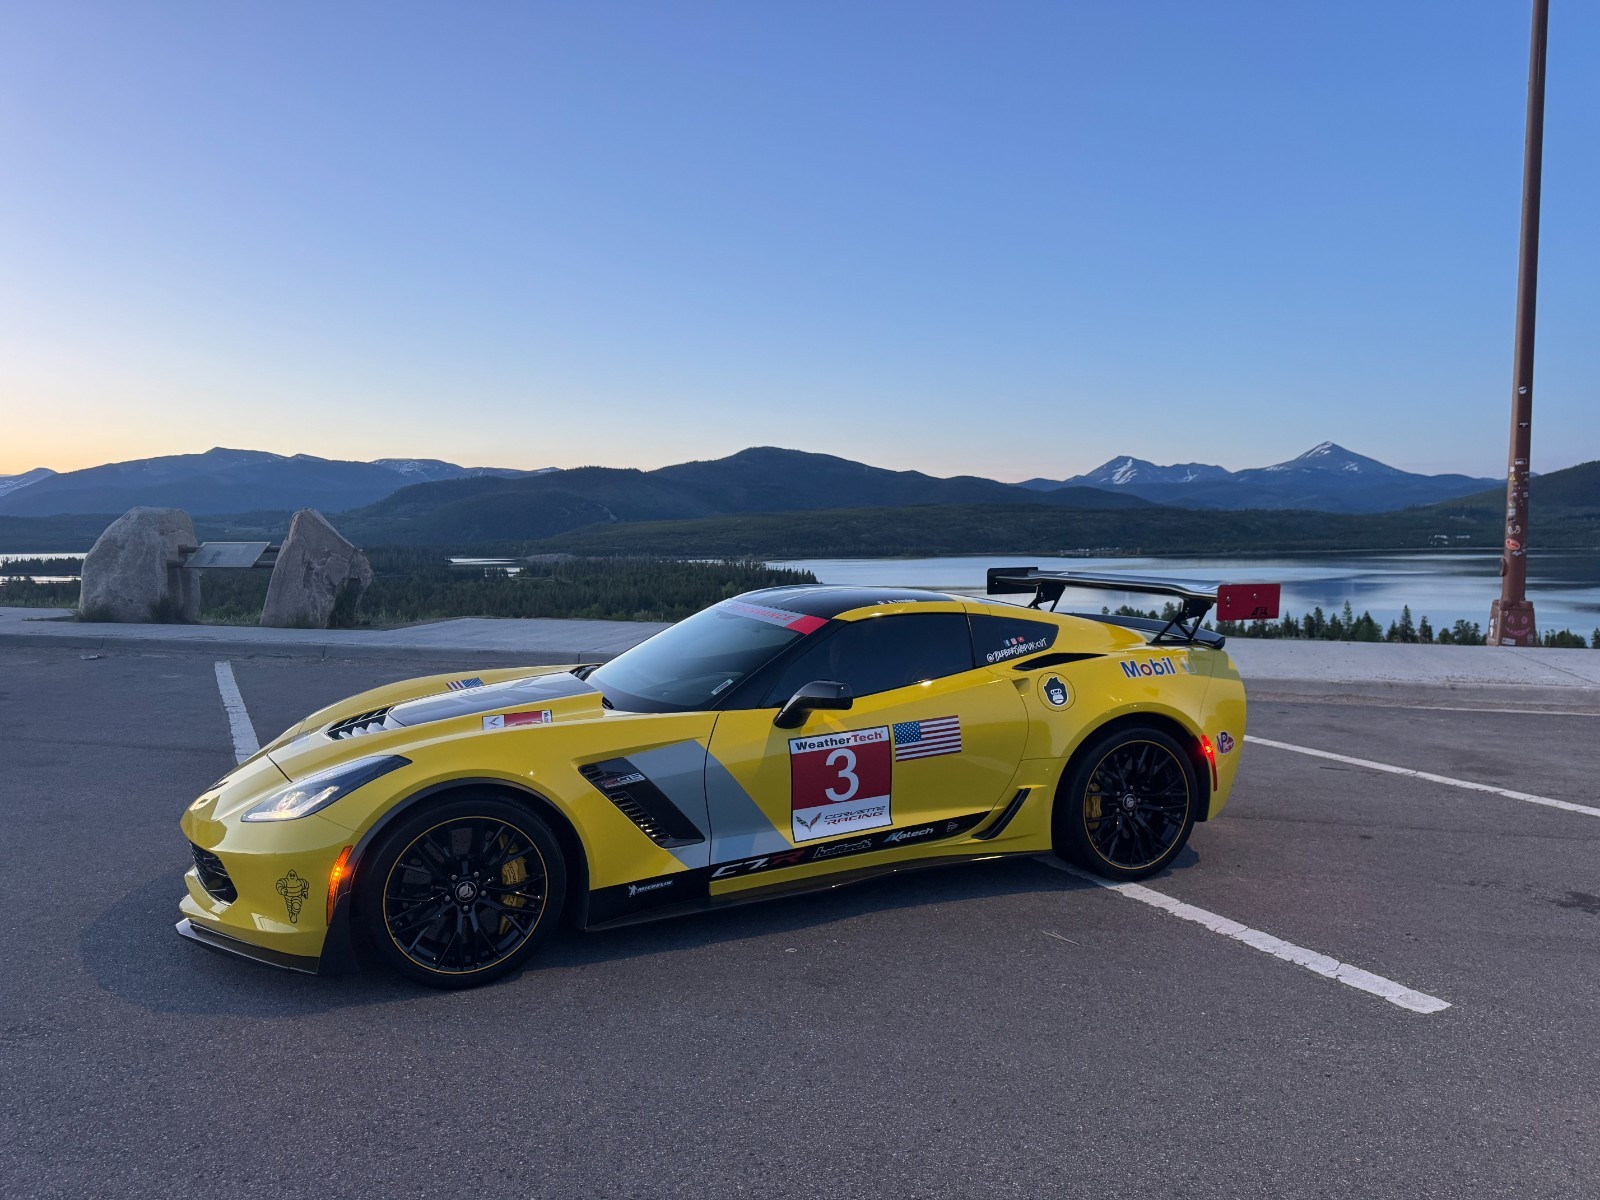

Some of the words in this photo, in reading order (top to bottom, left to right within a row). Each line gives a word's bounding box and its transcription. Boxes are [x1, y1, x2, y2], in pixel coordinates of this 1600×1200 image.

[1120, 657, 1176, 679] Mobil
[795, 730, 883, 751] WeatherTech
[825, 748, 860, 802] 3
[824, 805, 886, 820] CORVETTE
[824, 811, 884, 825] RACING
[885, 827, 934, 842] Katech
